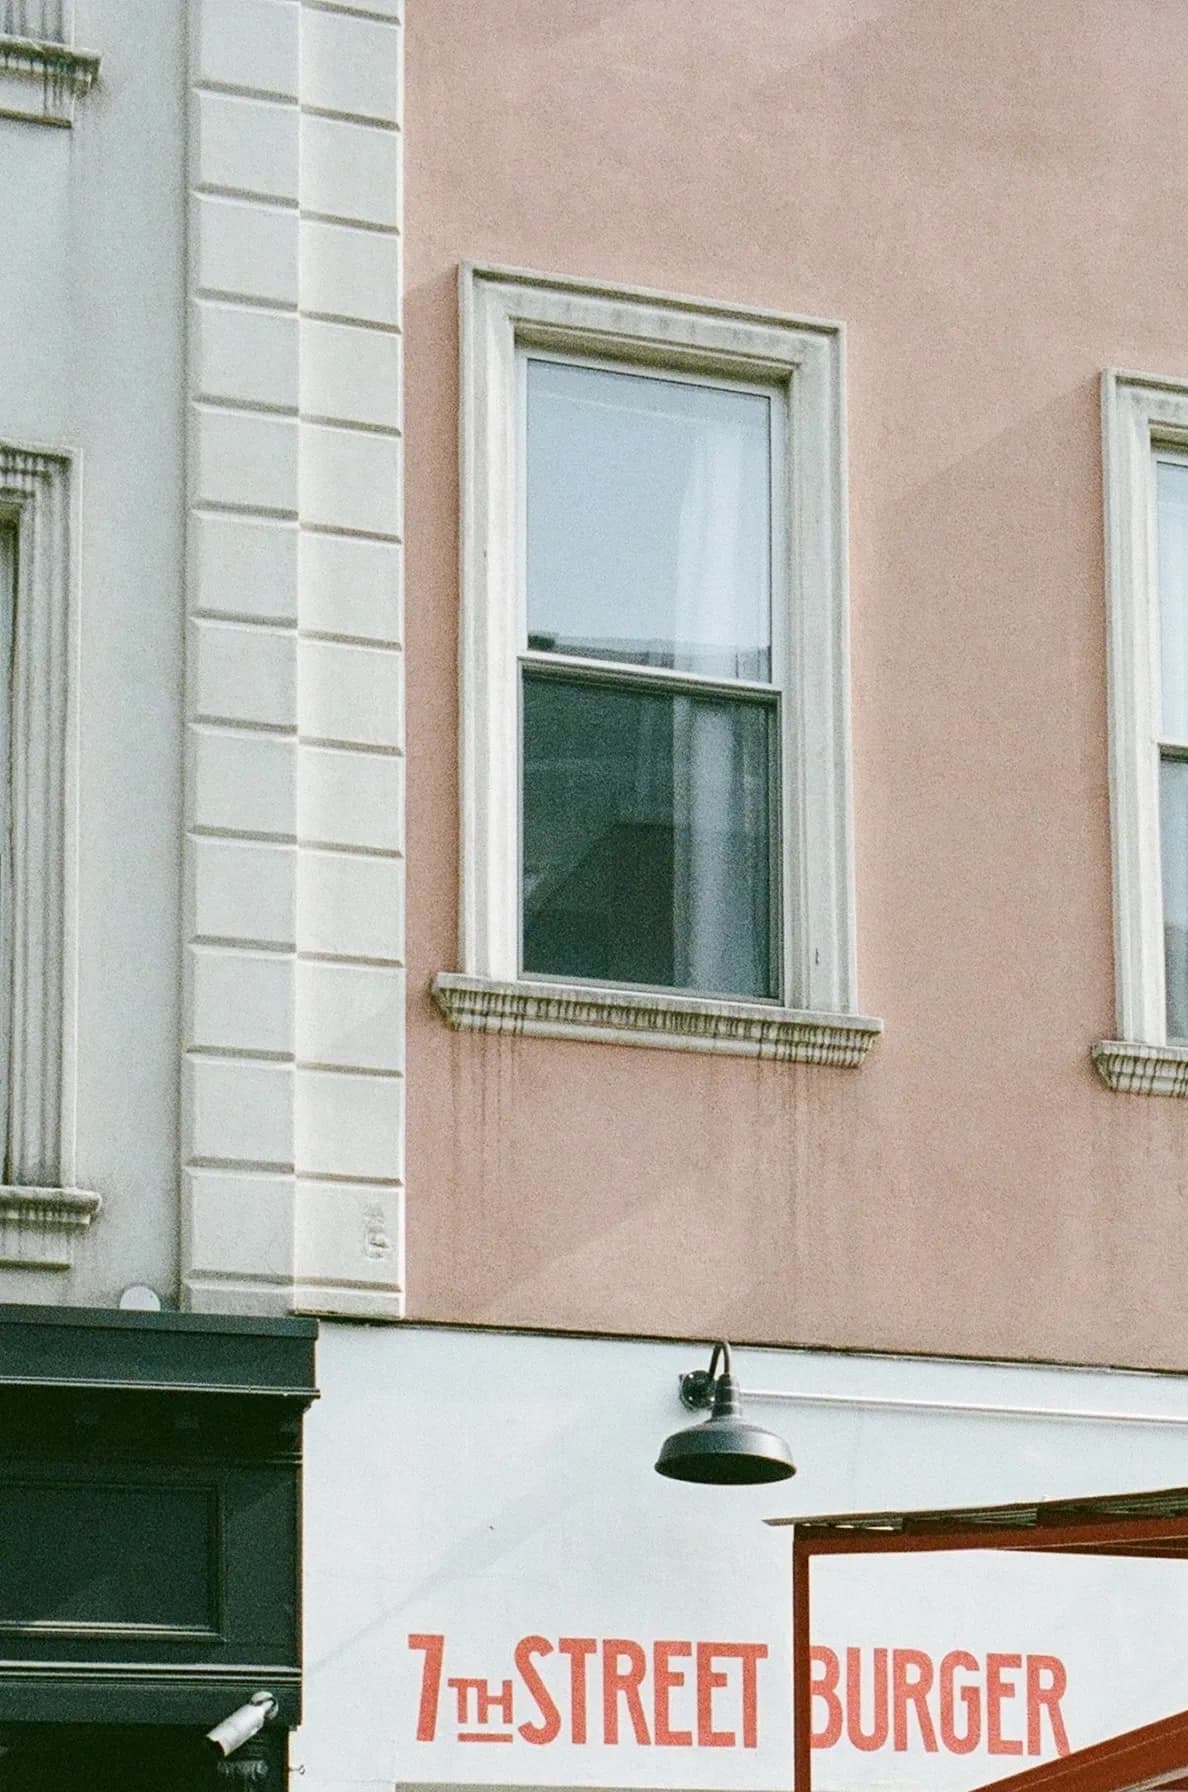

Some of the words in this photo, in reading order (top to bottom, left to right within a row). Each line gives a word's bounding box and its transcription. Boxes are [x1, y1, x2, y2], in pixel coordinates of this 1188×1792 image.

[408, 1634, 513, 1742] 7TH
[514, 1635, 768, 1748] STREET
[810, 1645, 1070, 1758] BURGER
